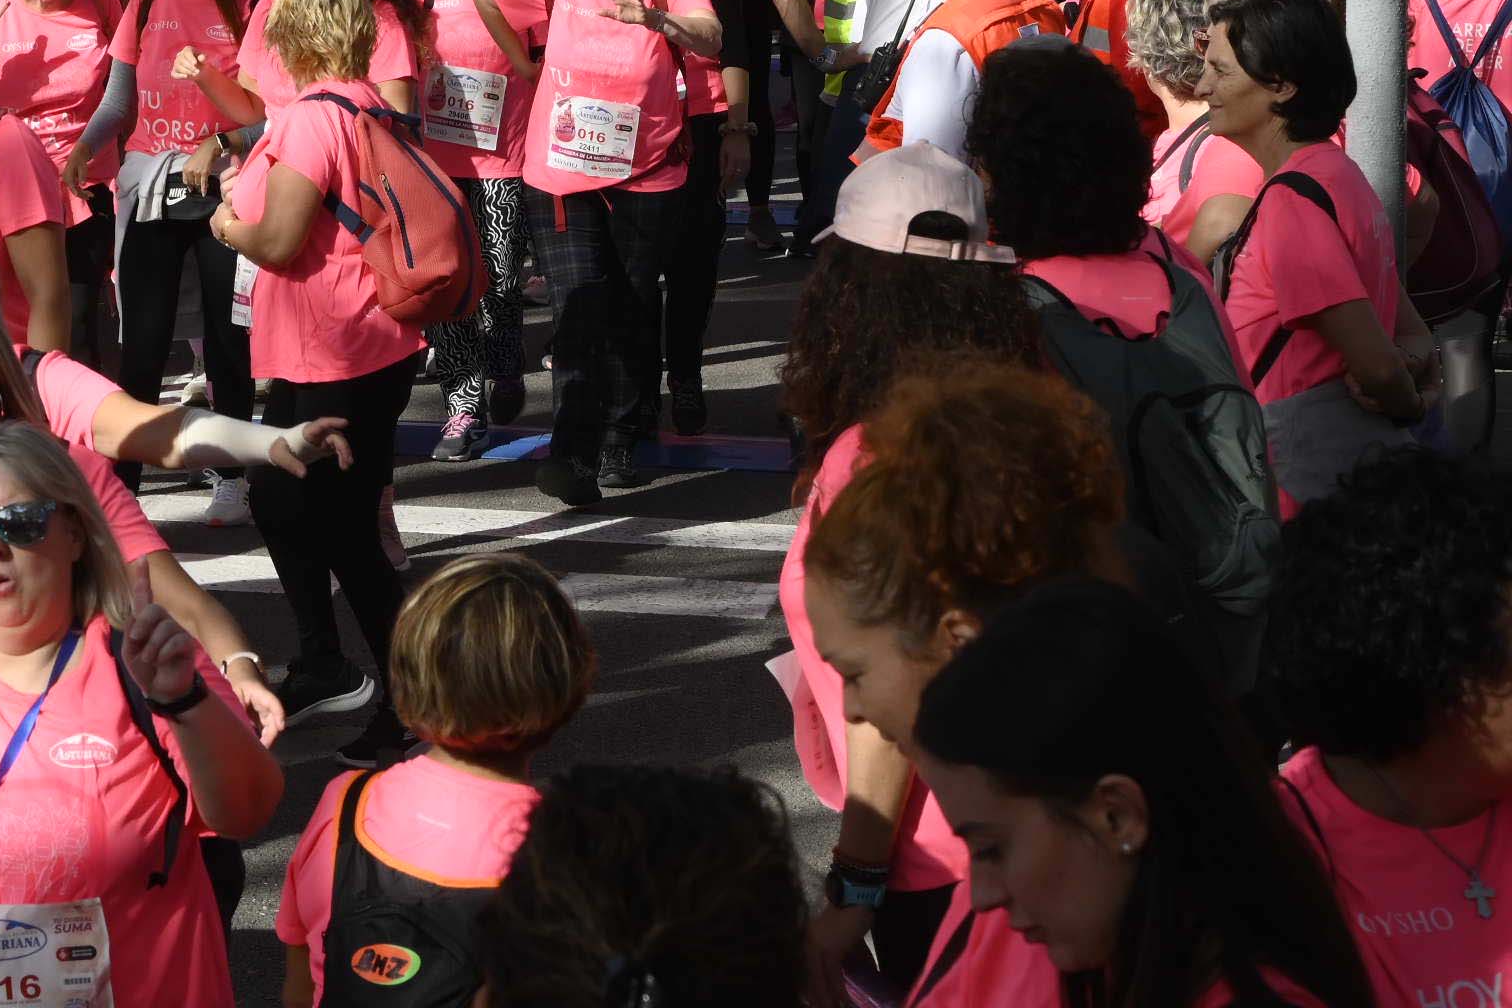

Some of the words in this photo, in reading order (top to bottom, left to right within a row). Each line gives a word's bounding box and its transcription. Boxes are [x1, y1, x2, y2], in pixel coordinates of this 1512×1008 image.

[549, 67, 571, 87] TU
[140, 90, 162, 110] TU
[447, 95, 475, 111] 016
[577, 128, 606, 144] 016
[168, 187, 187, 198] NIKE
[54, 923, 93, 934] SUMA
